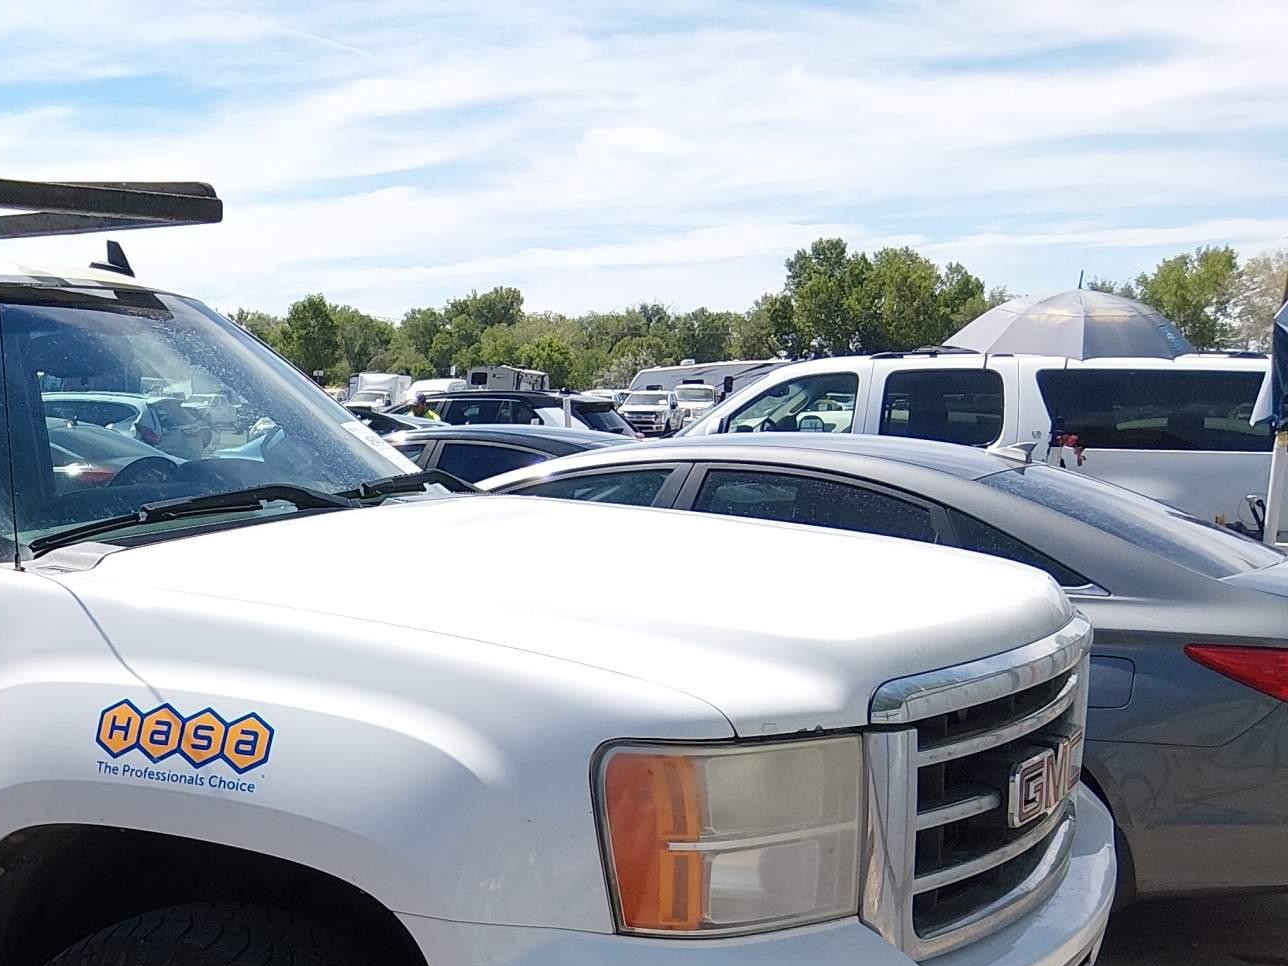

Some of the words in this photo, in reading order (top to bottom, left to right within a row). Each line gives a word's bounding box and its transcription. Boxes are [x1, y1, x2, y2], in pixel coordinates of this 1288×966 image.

[96, 760, 119, 775] The
[122, 763, 205, 787] Professionals
[208, 774, 256, 793] Choice
[1016, 729, 1083, 824] GMC
